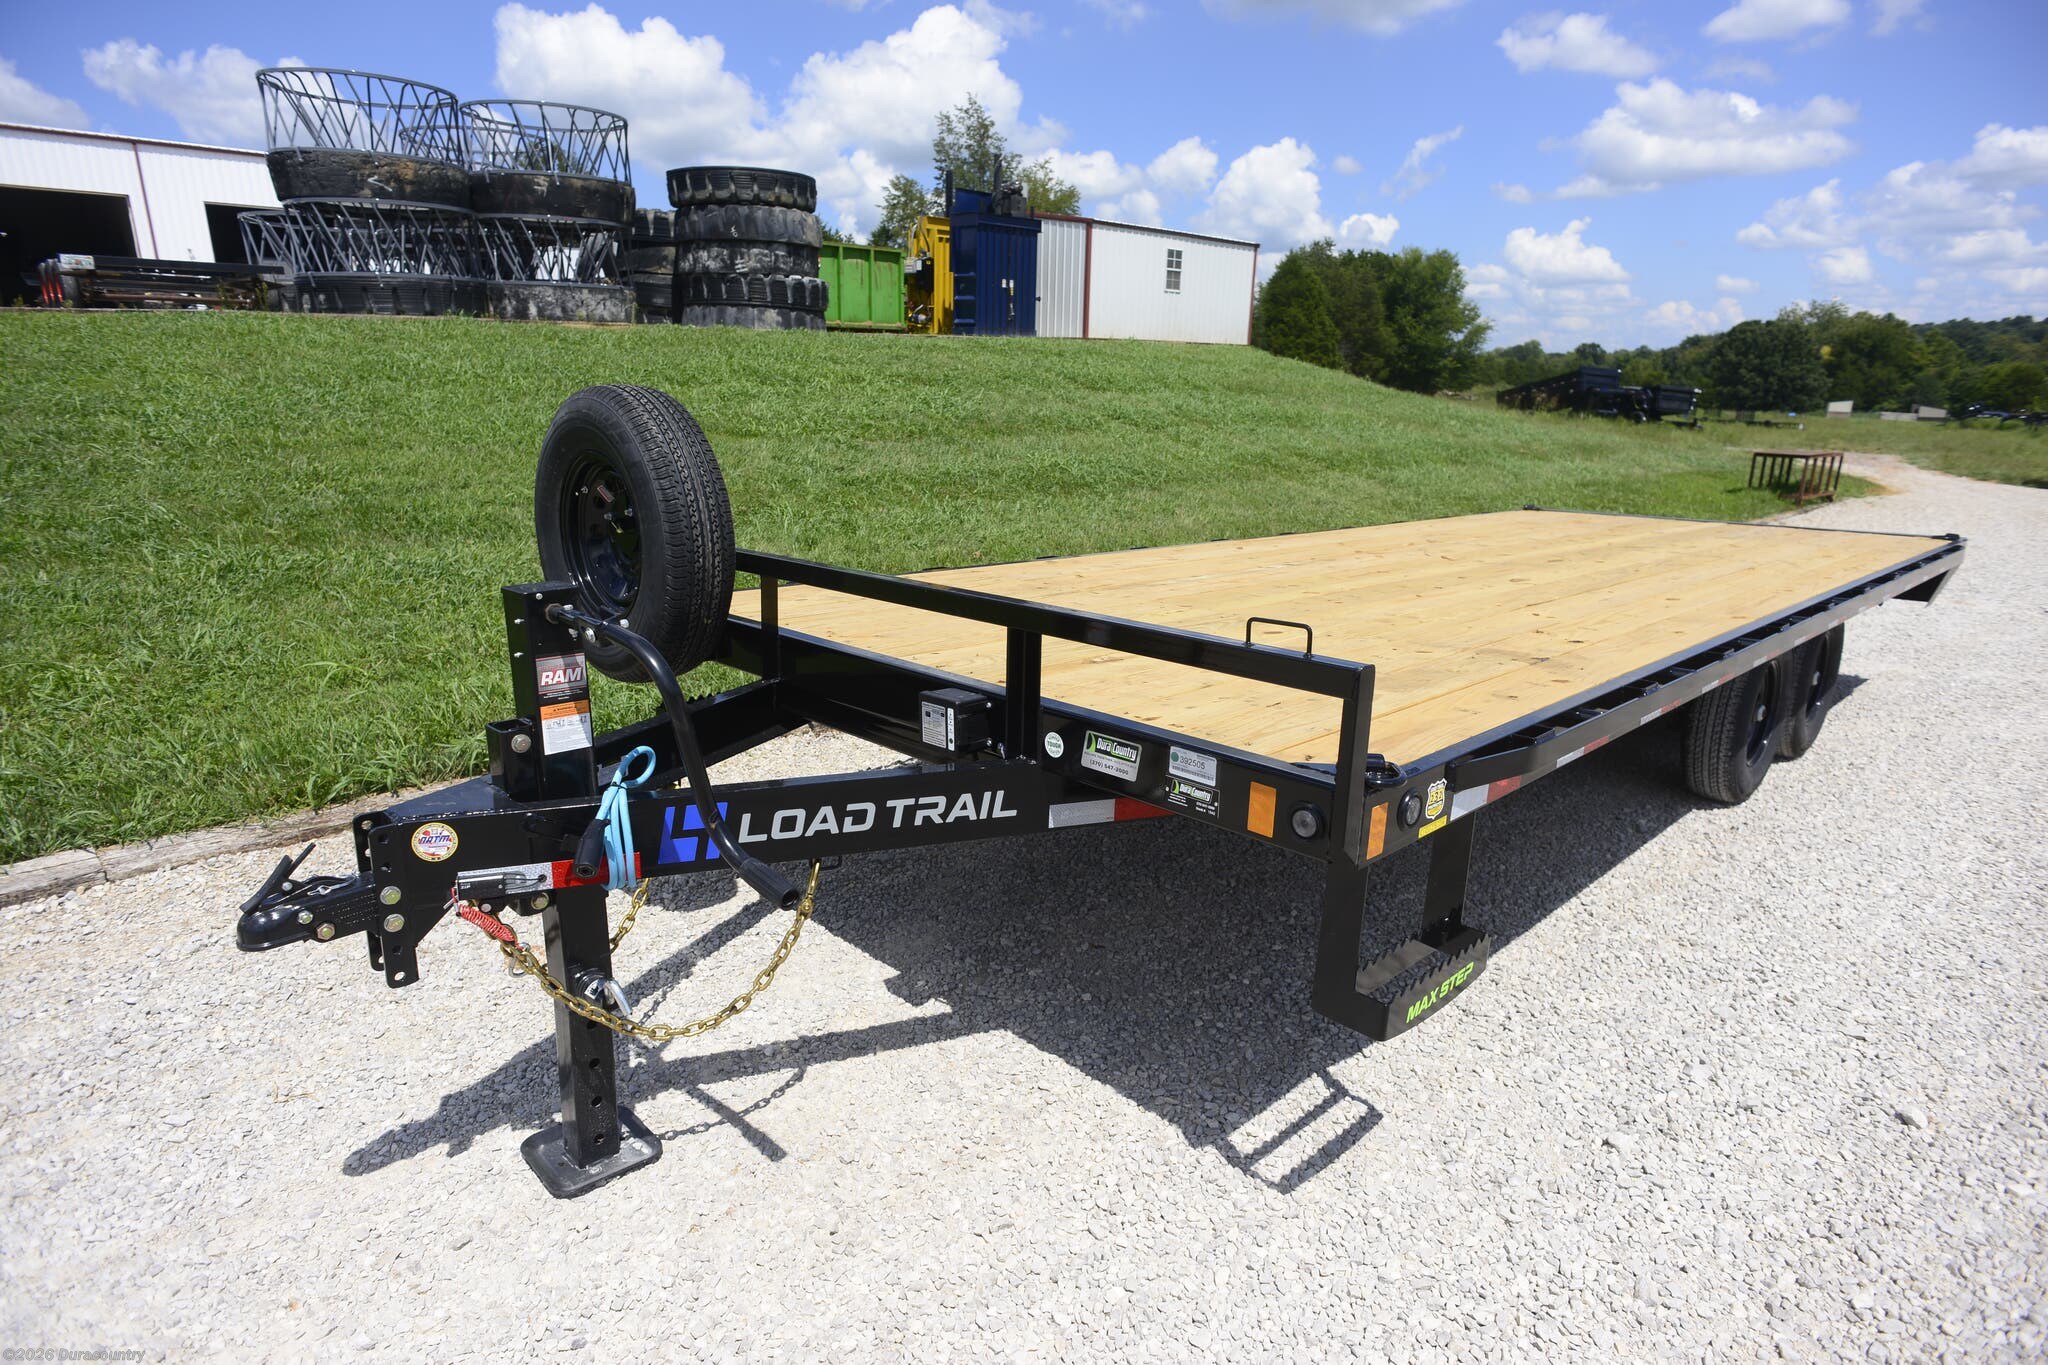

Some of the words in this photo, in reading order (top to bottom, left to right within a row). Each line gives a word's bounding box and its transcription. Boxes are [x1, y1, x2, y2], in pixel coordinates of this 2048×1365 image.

[541, 667, 582, 686] RAM
[738, 801, 876, 844] LOAD
[886, 790, 1018, 829] TRAIL
[1406, 986, 1439, 1024] MAX
[1439, 961, 1474, 999] STEP
